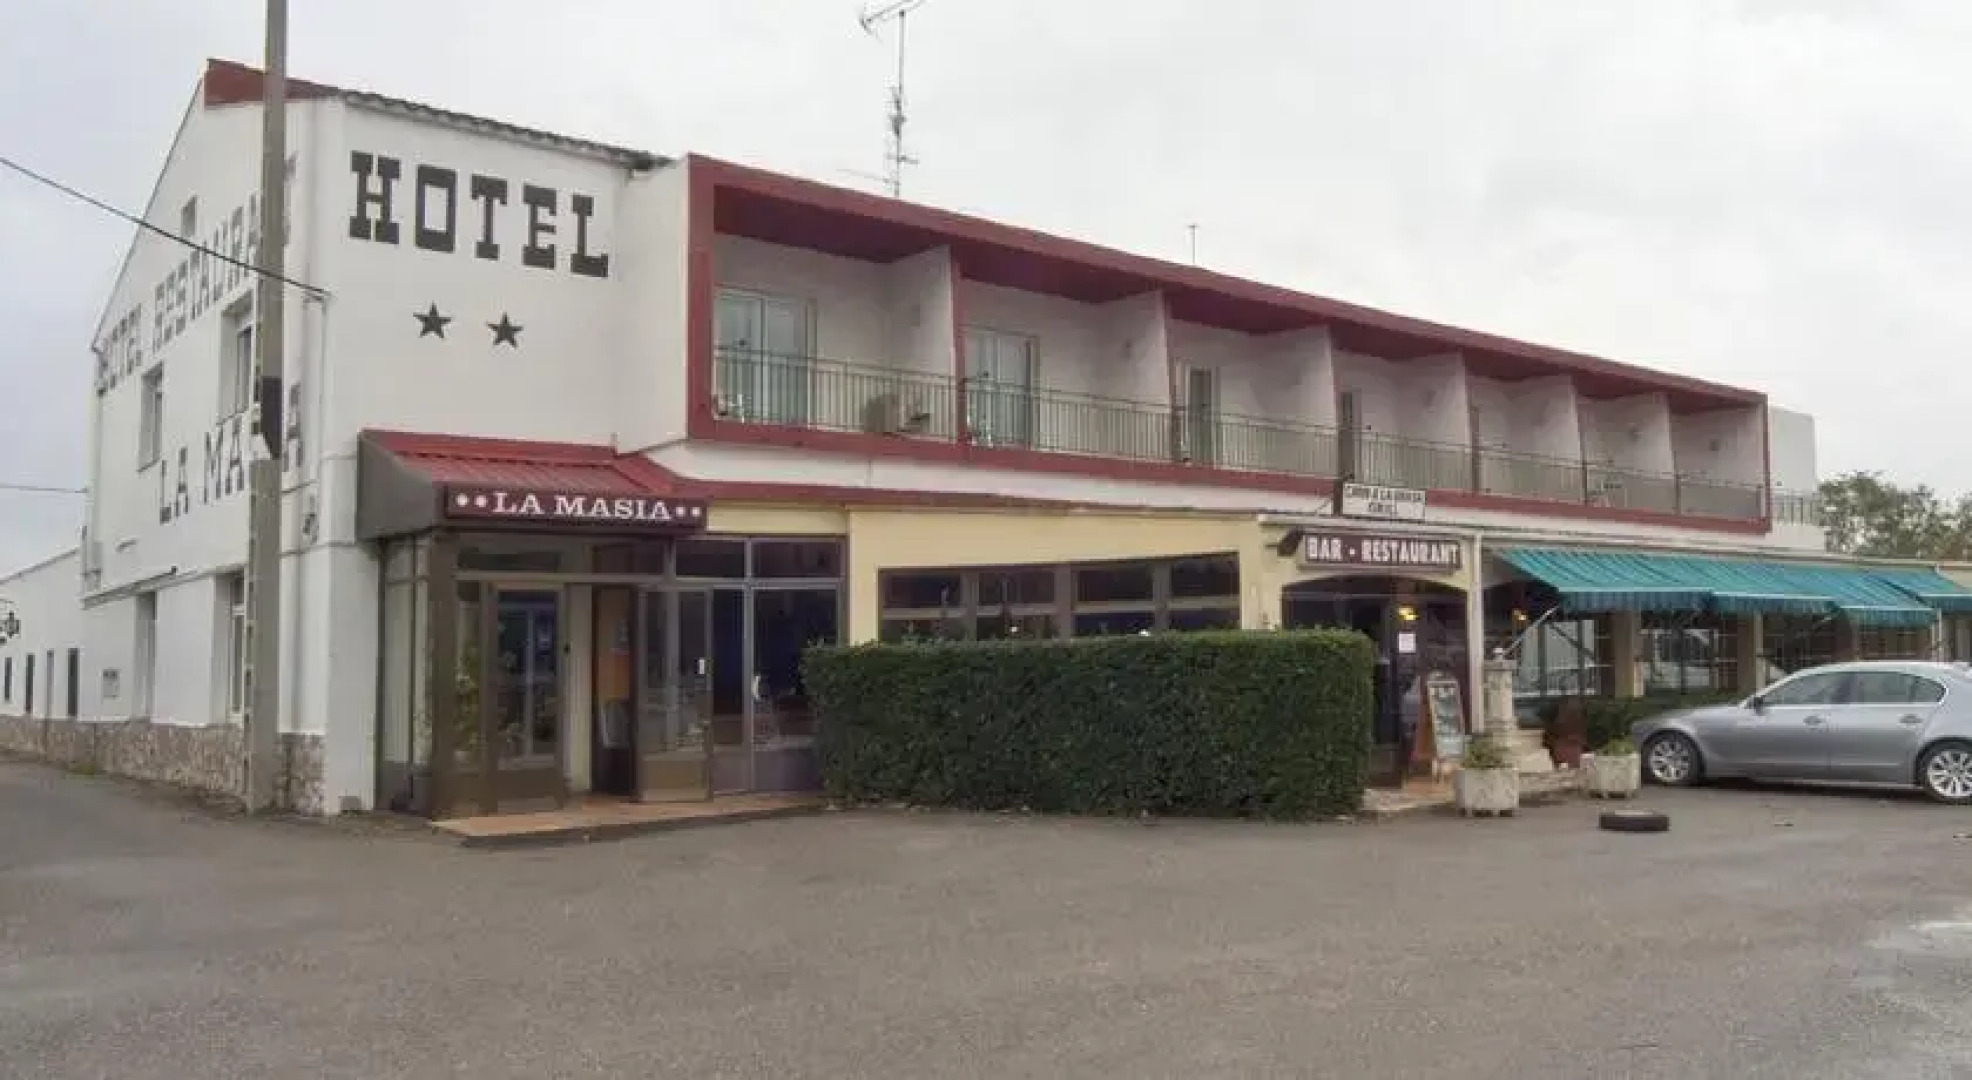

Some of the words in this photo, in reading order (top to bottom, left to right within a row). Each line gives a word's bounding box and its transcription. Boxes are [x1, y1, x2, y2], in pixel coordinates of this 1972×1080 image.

[349, 150, 609, 278] HOTEL
[160, 447, 188, 524] LA
[204, 382, 304, 505] MAA
[492, 492, 545, 515] LA
[554, 495, 672, 520] MASIA
[1307, 537, 1342, 560] BAR
[1361, 539, 1459, 564] RESTAURANT
